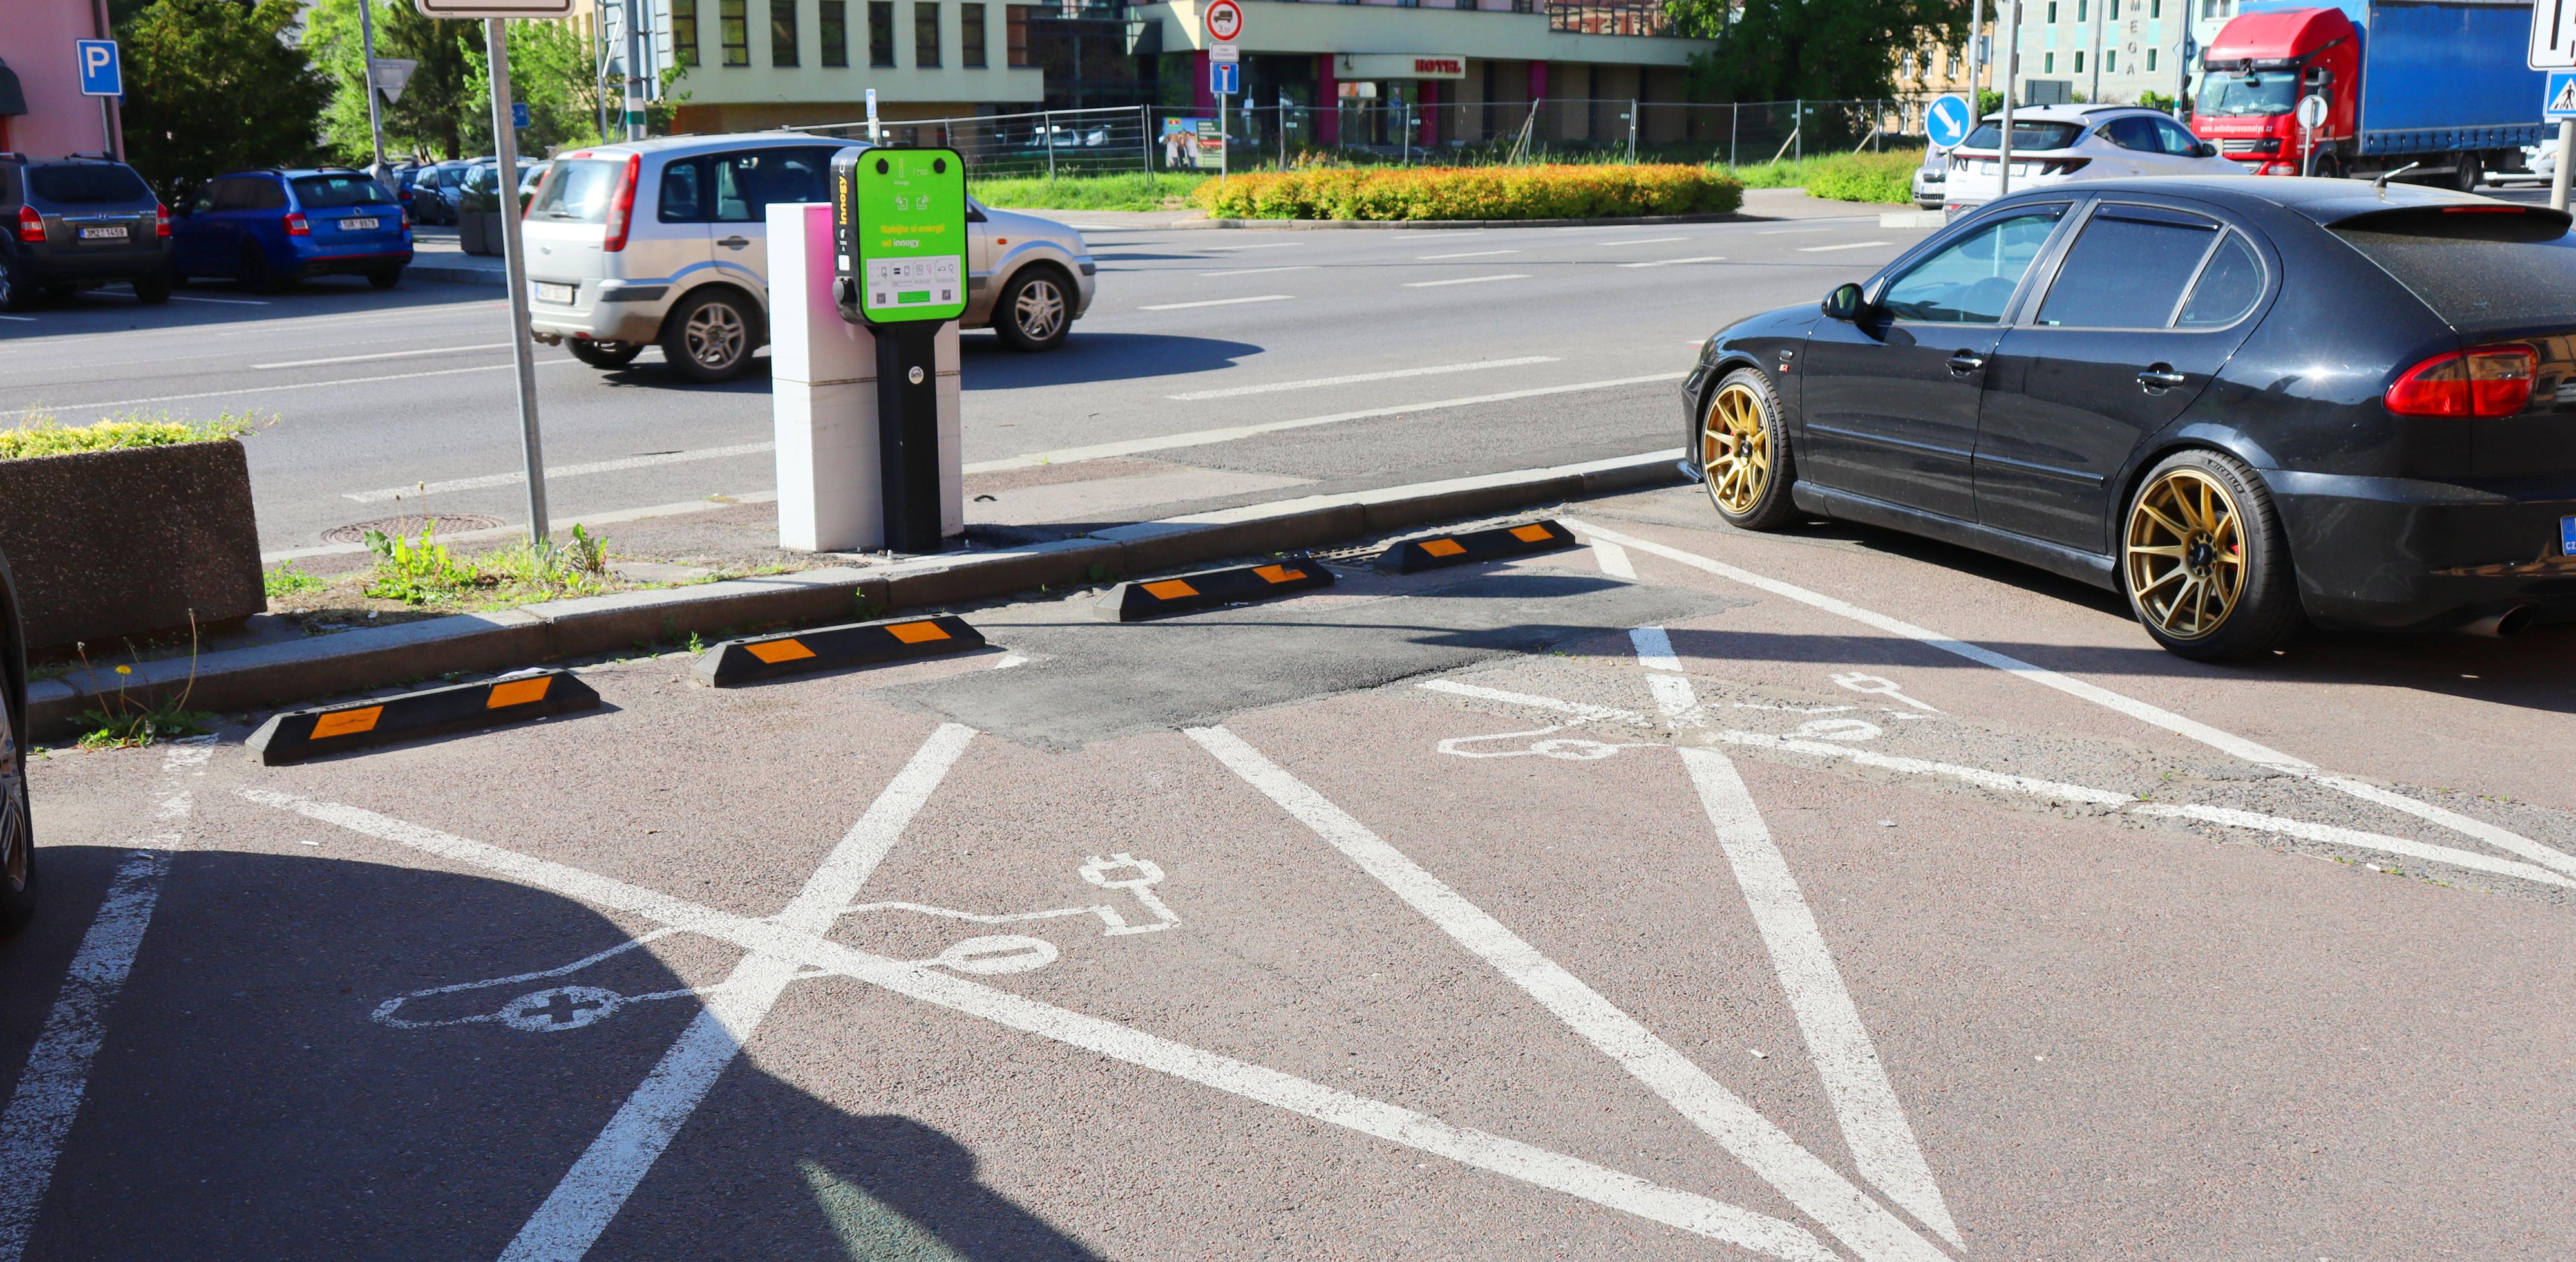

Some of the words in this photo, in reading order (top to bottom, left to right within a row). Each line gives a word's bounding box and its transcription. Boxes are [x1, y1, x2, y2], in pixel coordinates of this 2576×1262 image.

[86, 46, 110, 78] P
[1416, 59, 1461, 73] HOTEL
[86, 227, 100, 237] 3M2
[107, 227, 124, 237] 1459
[882, 239, 892, 247] od
[2210, 460, 2244, 493] MICHELIN
[2566, 542, 2576, 551] CZ
